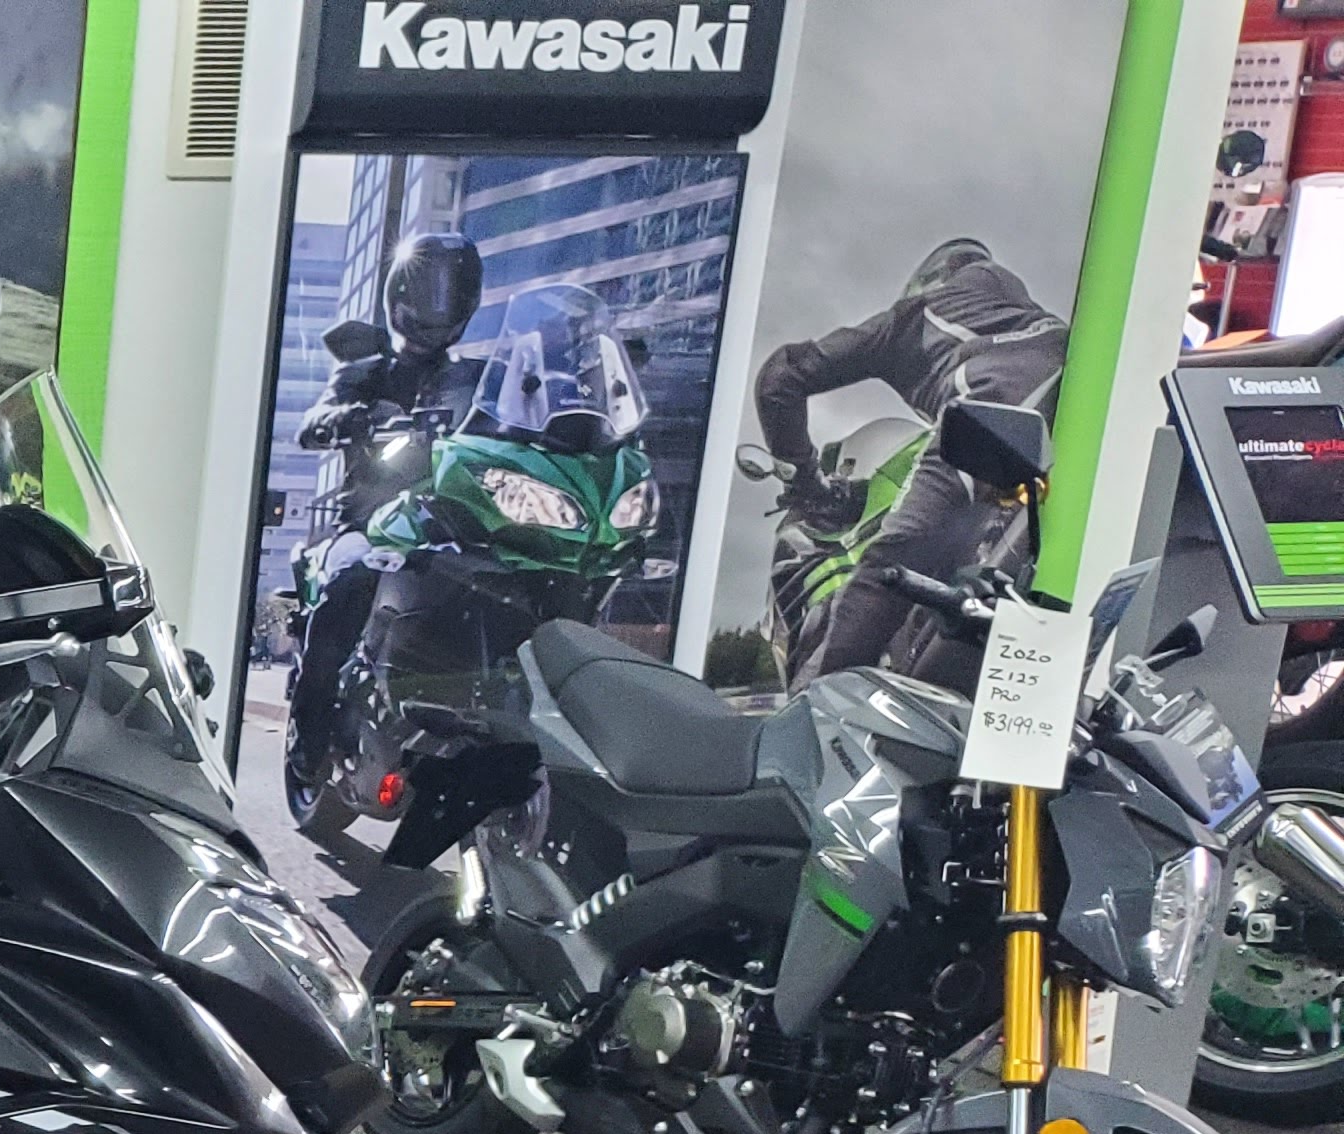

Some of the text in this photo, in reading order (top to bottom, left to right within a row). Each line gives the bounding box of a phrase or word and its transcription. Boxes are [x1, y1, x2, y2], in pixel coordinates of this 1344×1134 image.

[358, 0, 751, 73] Kawasaki
[1228, 376, 1322, 395] Kawasaki
[999, 644, 1052, 663] 2020
[987, 667, 1040, 686] Z125
